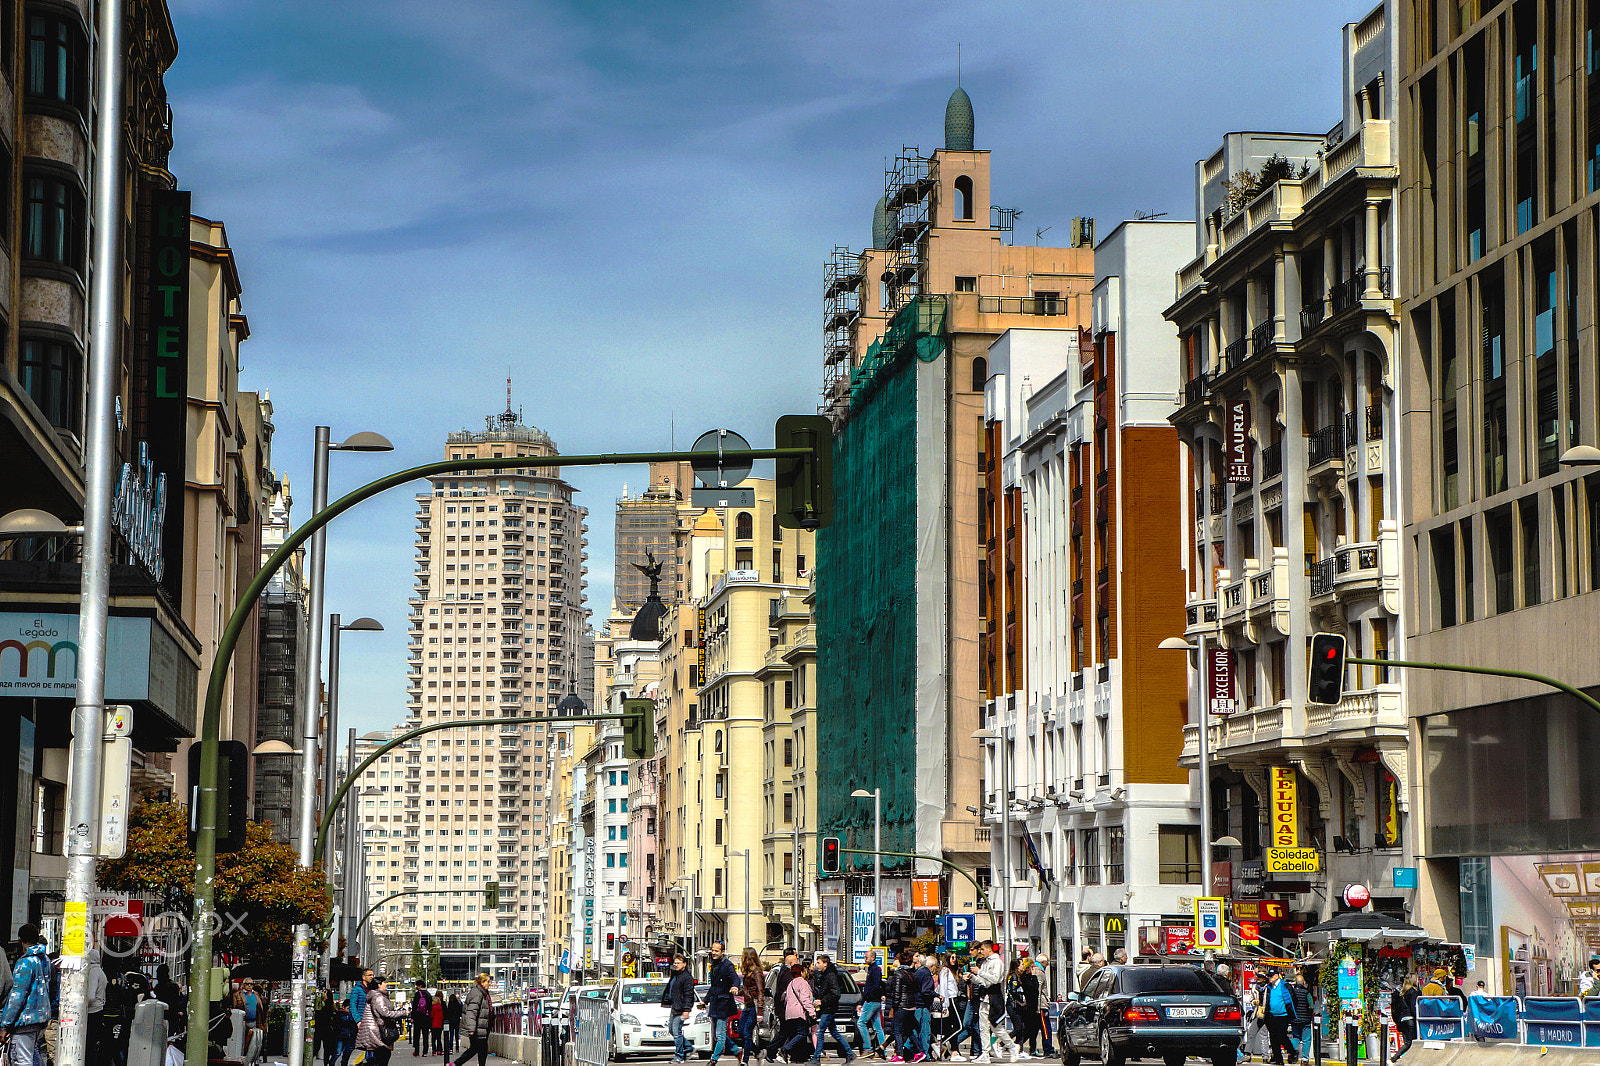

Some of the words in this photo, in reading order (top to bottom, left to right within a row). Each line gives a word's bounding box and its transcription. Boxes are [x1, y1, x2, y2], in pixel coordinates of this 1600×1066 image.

[156, 204, 183, 398] HOTEL
[1233, 403, 1245, 463] LAURIA
[34, 618, 43, 628] El
[19, 627, 59, 639] Legado
[1215, 651, 1229, 699] EXCELSIOR
[1276, 768, 1294, 846] PELUCAS
[1270, 849, 1316, 859] Soledad
[585, 838, 595, 896] SENATOR
[1272, 860, 1314, 871] Cabello
[854, 896, 863, 912] EL
[585, 898, 594, 945] HOTEL
[854, 911, 876, 927] MAGO
[854, 926, 869, 942] POP
[952, 917, 968, 940] P
[1379, 946, 1413, 958] Coca-Cola
[1547, 1029, 1573, 1042] MADRID
